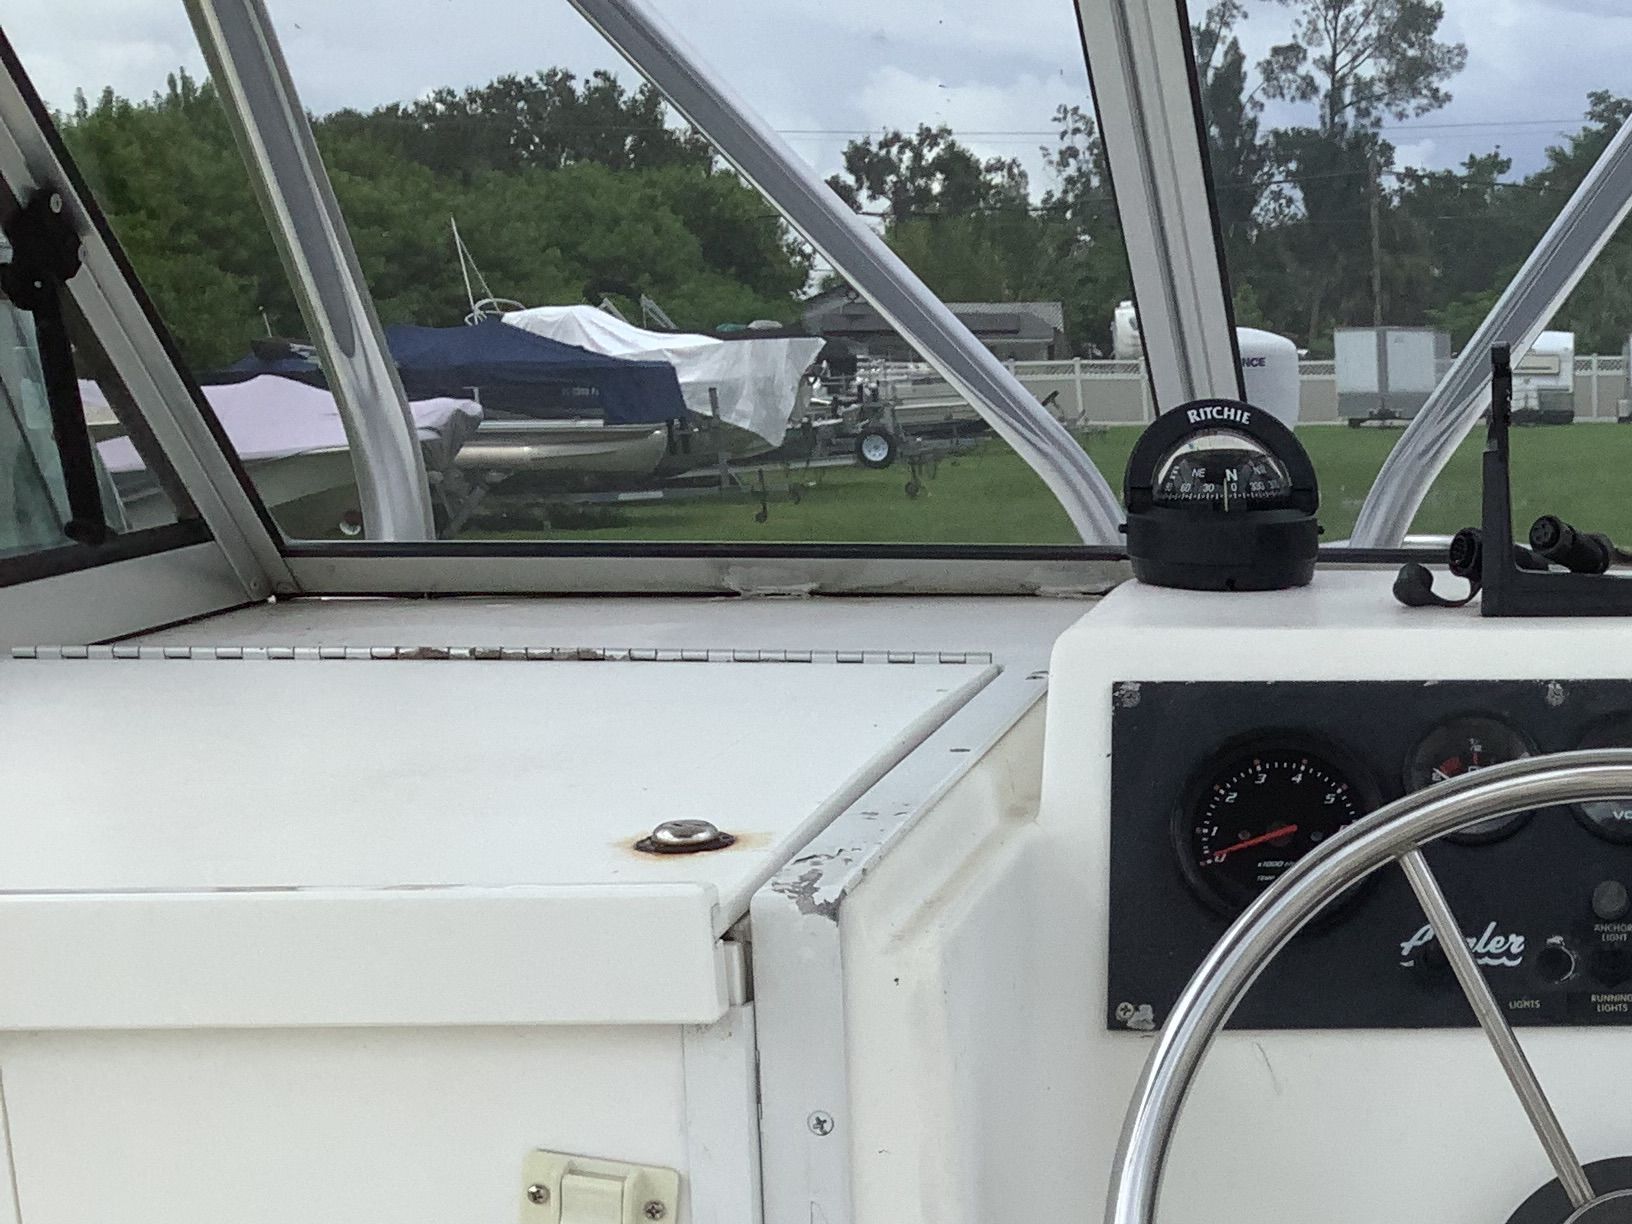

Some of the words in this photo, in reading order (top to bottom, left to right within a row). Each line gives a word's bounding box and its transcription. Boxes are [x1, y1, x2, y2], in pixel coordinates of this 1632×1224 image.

[1242, 357, 1266, 367] NCE
[1187, 406, 1251, 425] RITCHIE
[1192, 468, 1206, 478] NE
[1225, 468, 1238, 481] N
[1180, 483, 1191, 492] 60
[1202, 483, 1215, 492] 30
[1231, 482, 1237, 492] 0
[1254, 773, 1267, 784] 3
[1291, 773, 1303, 784] 4
[1225, 792, 1238, 803] 2
[1324, 794, 1336, 804] 5
[1211, 826, 1219, 836] 1
[1594, 923, 1632, 932] ANCHOR
[1602, 933, 1627, 942] LIGHT
[1509, 999, 1541, 1009] LIGHTS
[1596, 1003, 1628, 1012] LIGHTS
